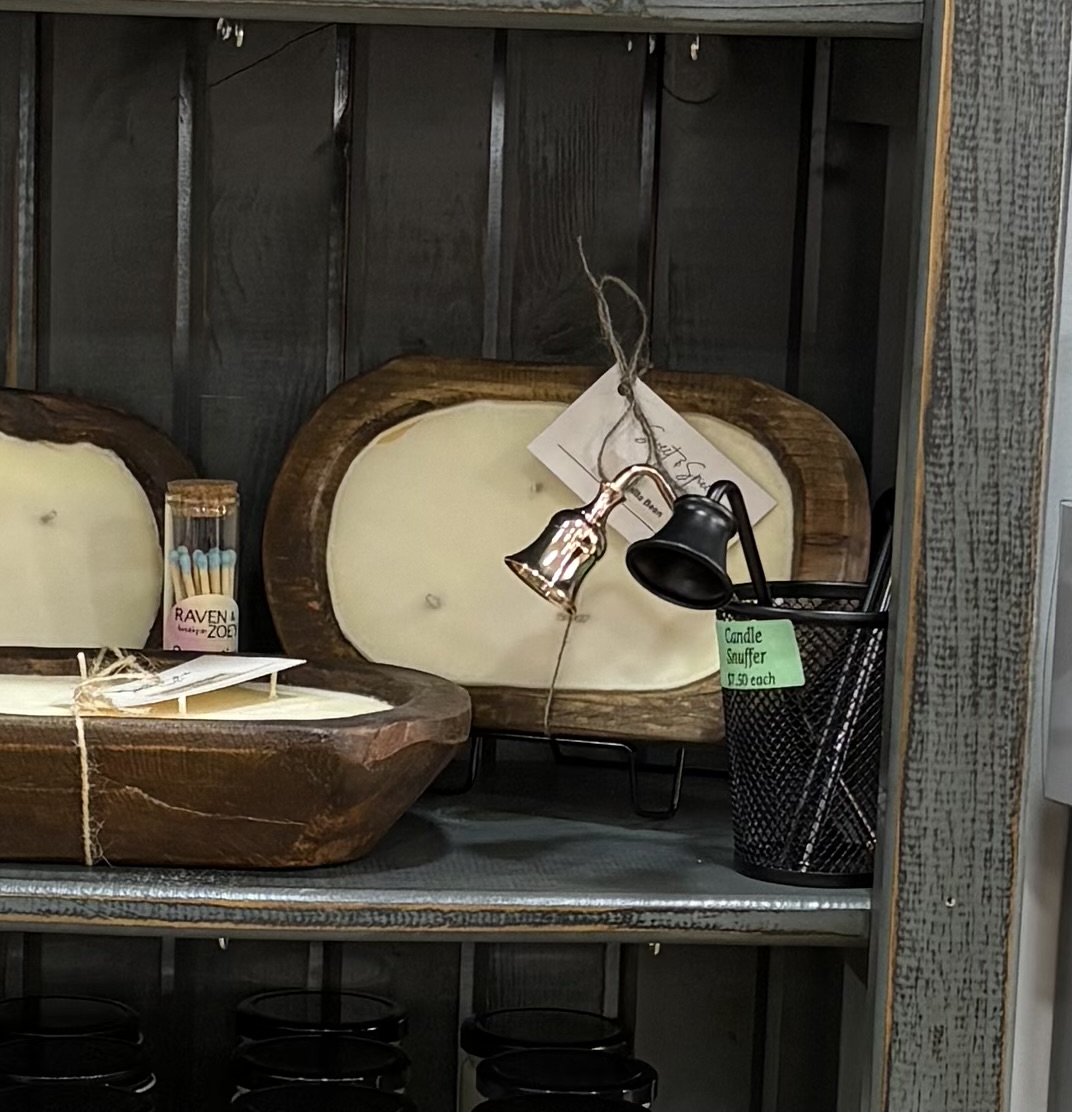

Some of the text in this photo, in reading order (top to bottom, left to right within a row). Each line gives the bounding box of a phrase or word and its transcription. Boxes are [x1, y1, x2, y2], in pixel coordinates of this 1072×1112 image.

[175, 607, 227, 624] RAVEN
[725, 626, 763, 644] Candle
[726, 647, 767, 669] Snuffer
[751, 671, 776, 686] each
